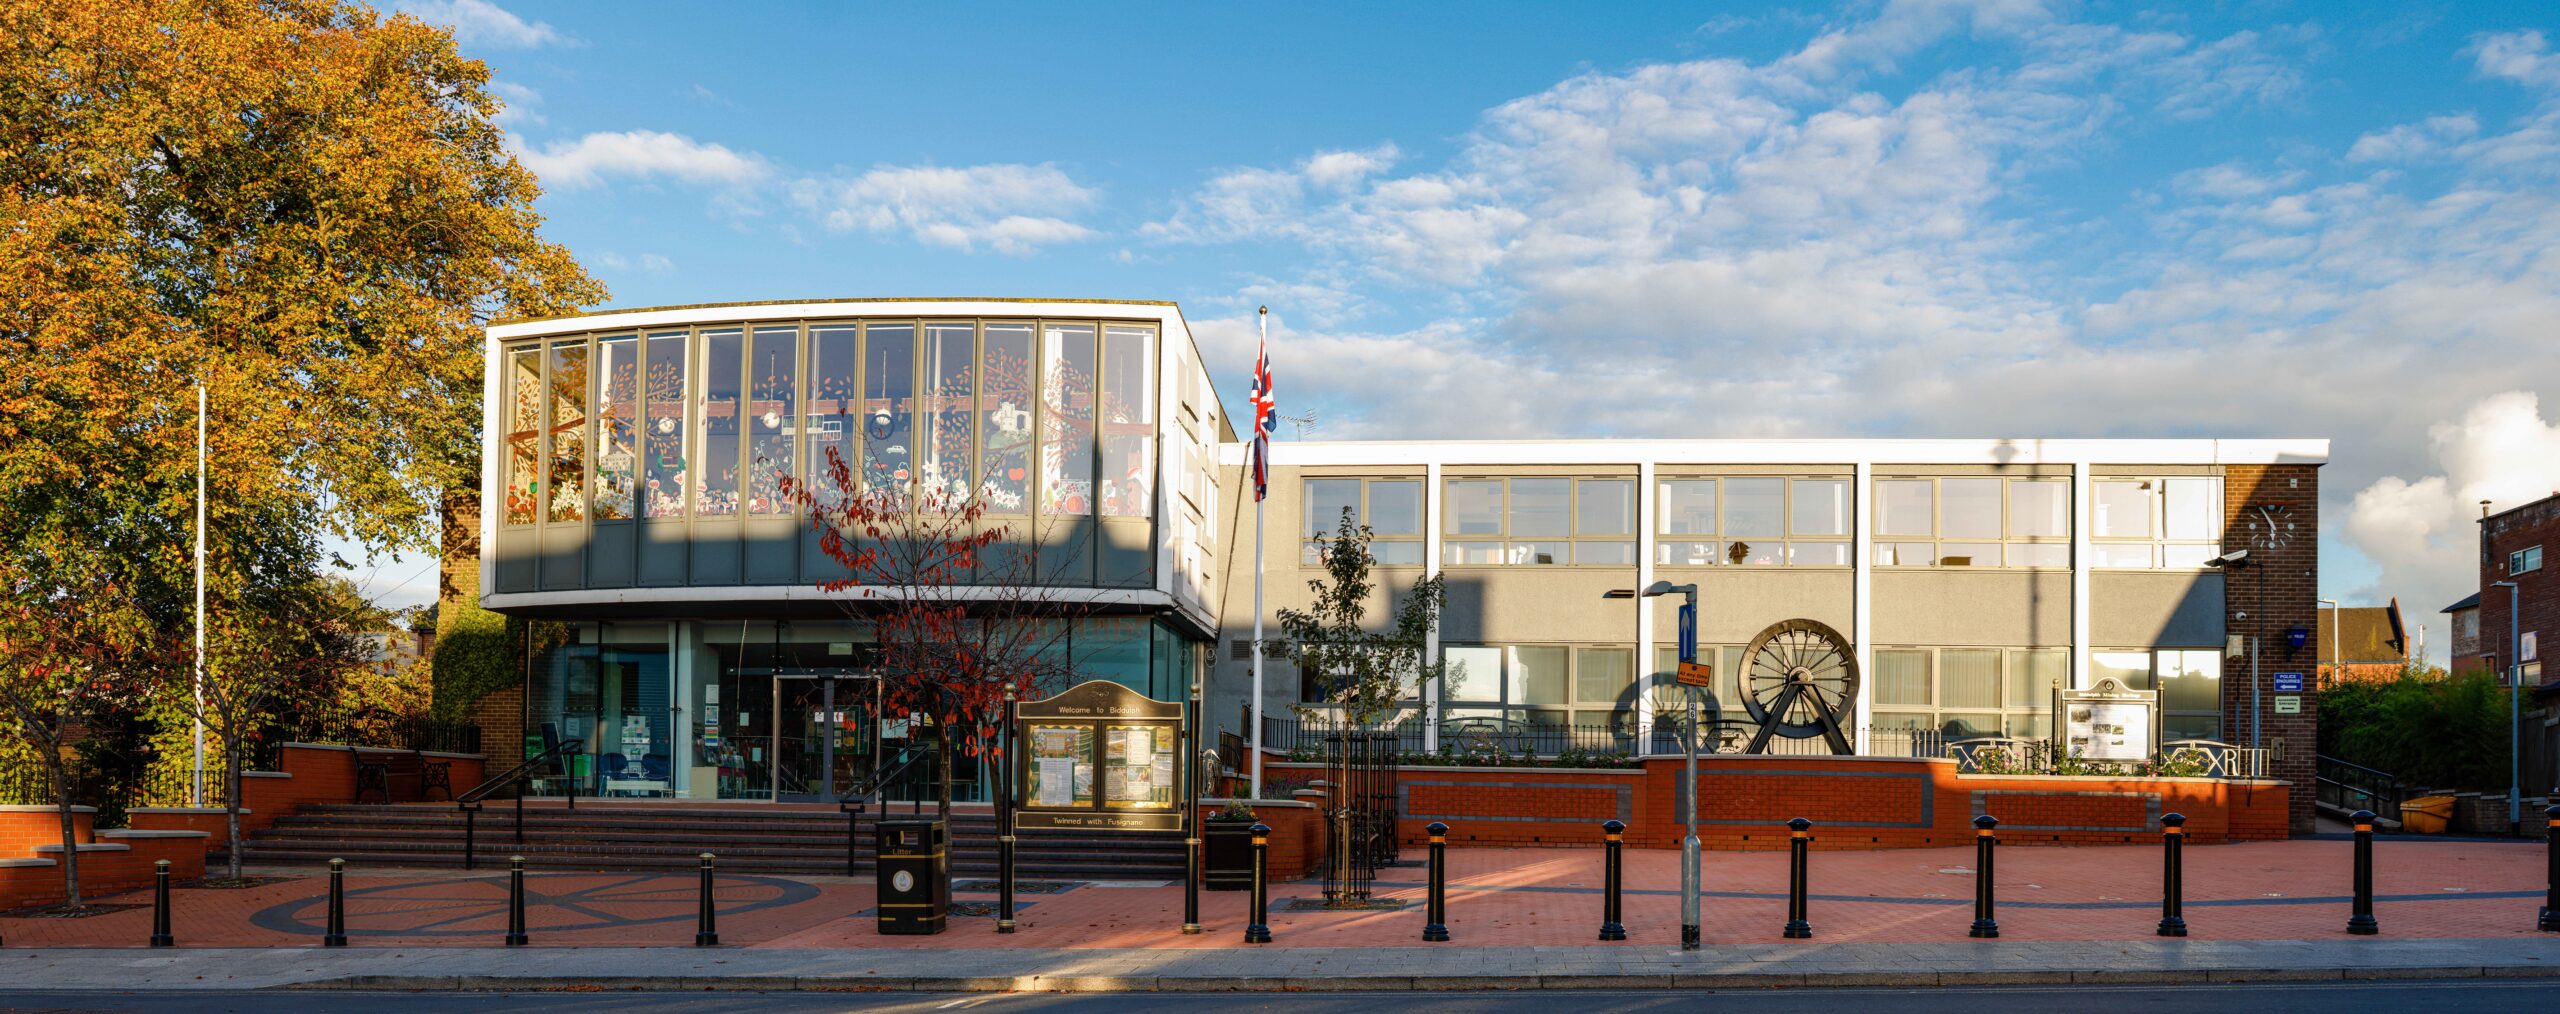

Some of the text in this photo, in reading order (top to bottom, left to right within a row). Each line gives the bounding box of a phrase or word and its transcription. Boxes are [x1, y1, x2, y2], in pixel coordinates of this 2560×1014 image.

[1059, 706, 1140, 714] Welcome to Biddulph
[1053, 817, 1082, 825] Twinned
[1107, 818, 1143, 827] Fusignano
